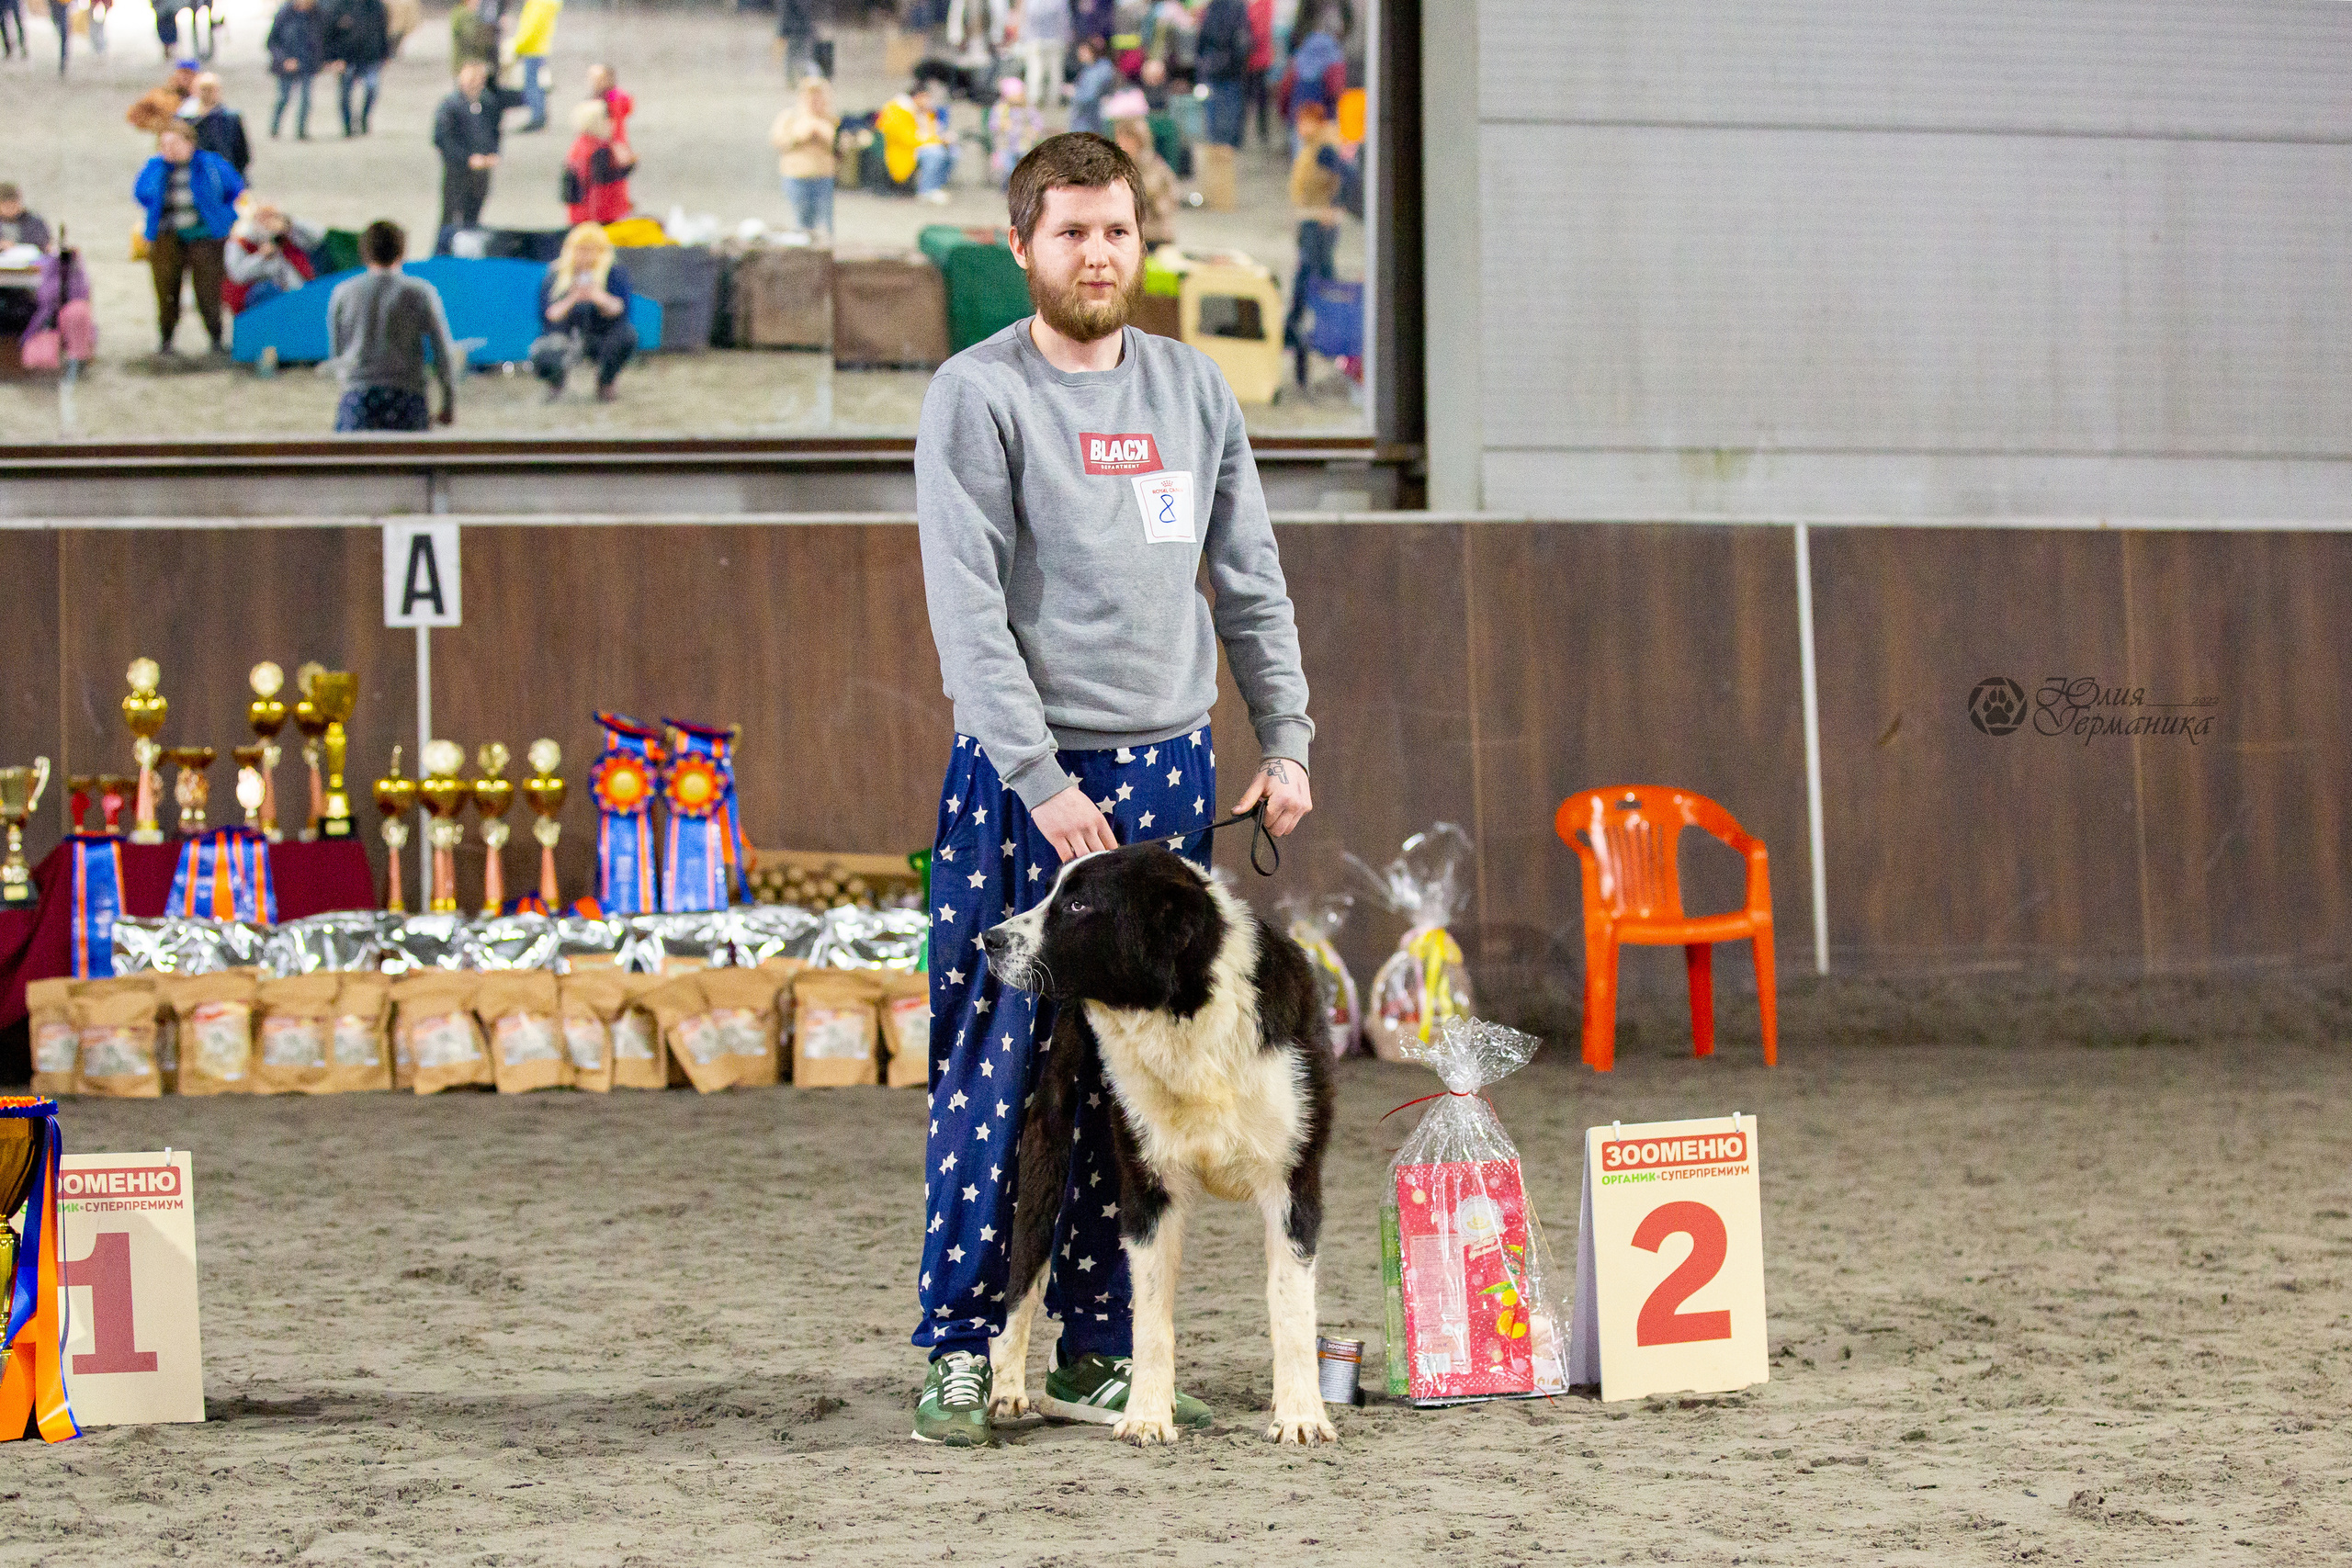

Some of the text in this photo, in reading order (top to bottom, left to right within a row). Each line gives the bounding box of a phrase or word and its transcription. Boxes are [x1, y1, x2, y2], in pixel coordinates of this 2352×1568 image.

[1090, 439, 1148, 461] BLACK
[1159, 494, 1177, 523] 8
[401, 534, 446, 615] A
[1606, 1137, 1743, 1167] ЗООМЕНЮ
[58, 1171, 176, 1195] ОМЕНЮ
[1630, 1200, 1733, 1347] 2
[58, 1232, 158, 1375] 1
